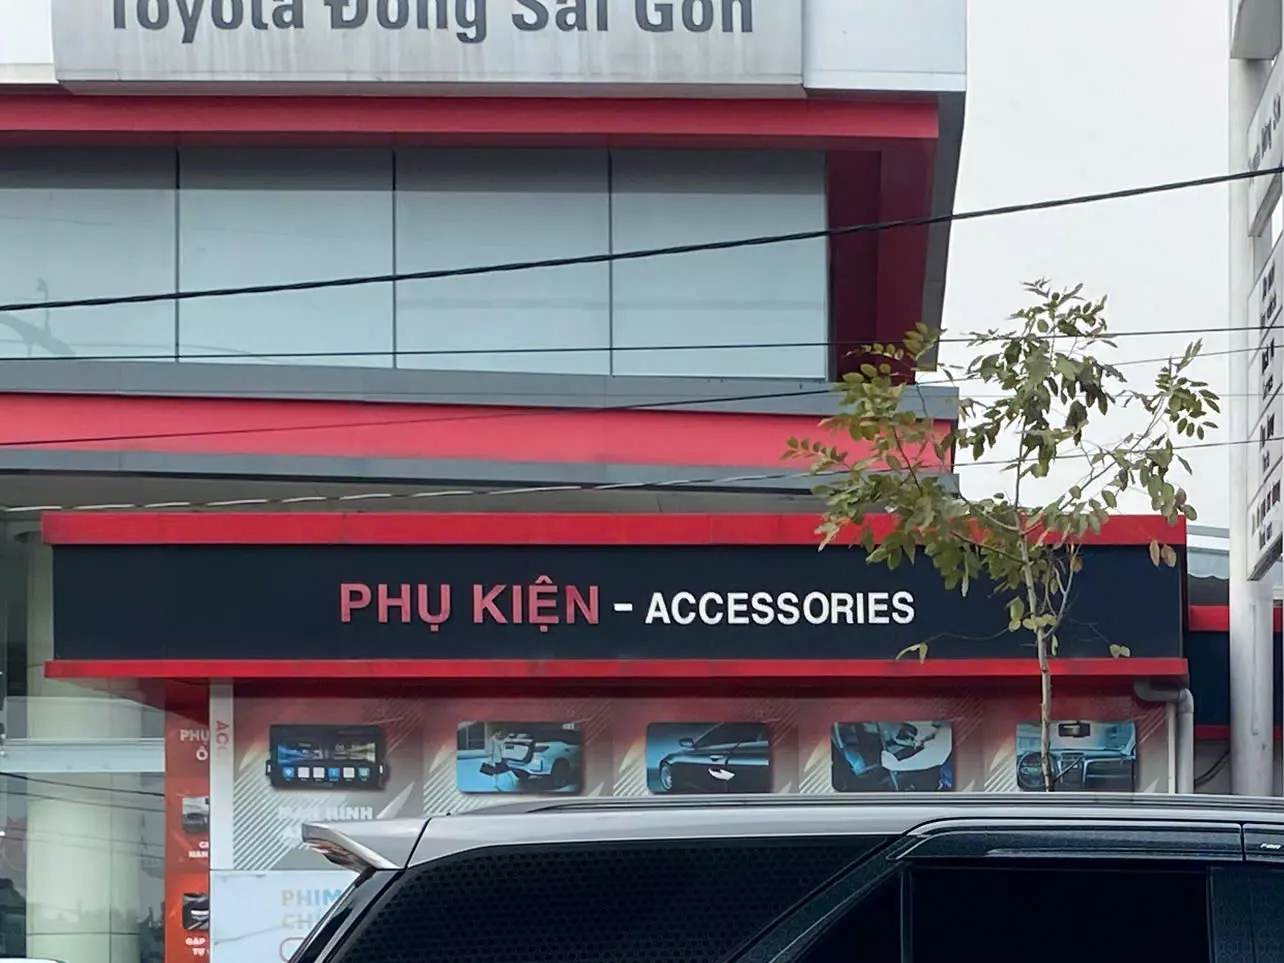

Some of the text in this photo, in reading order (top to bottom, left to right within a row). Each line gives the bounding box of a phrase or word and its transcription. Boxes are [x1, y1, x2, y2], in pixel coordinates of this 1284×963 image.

[340, 583, 452, 632] PHỤ
[472, 574, 600, 633] KIỆN
[645, 590, 916, 625] ACCESSORIES
